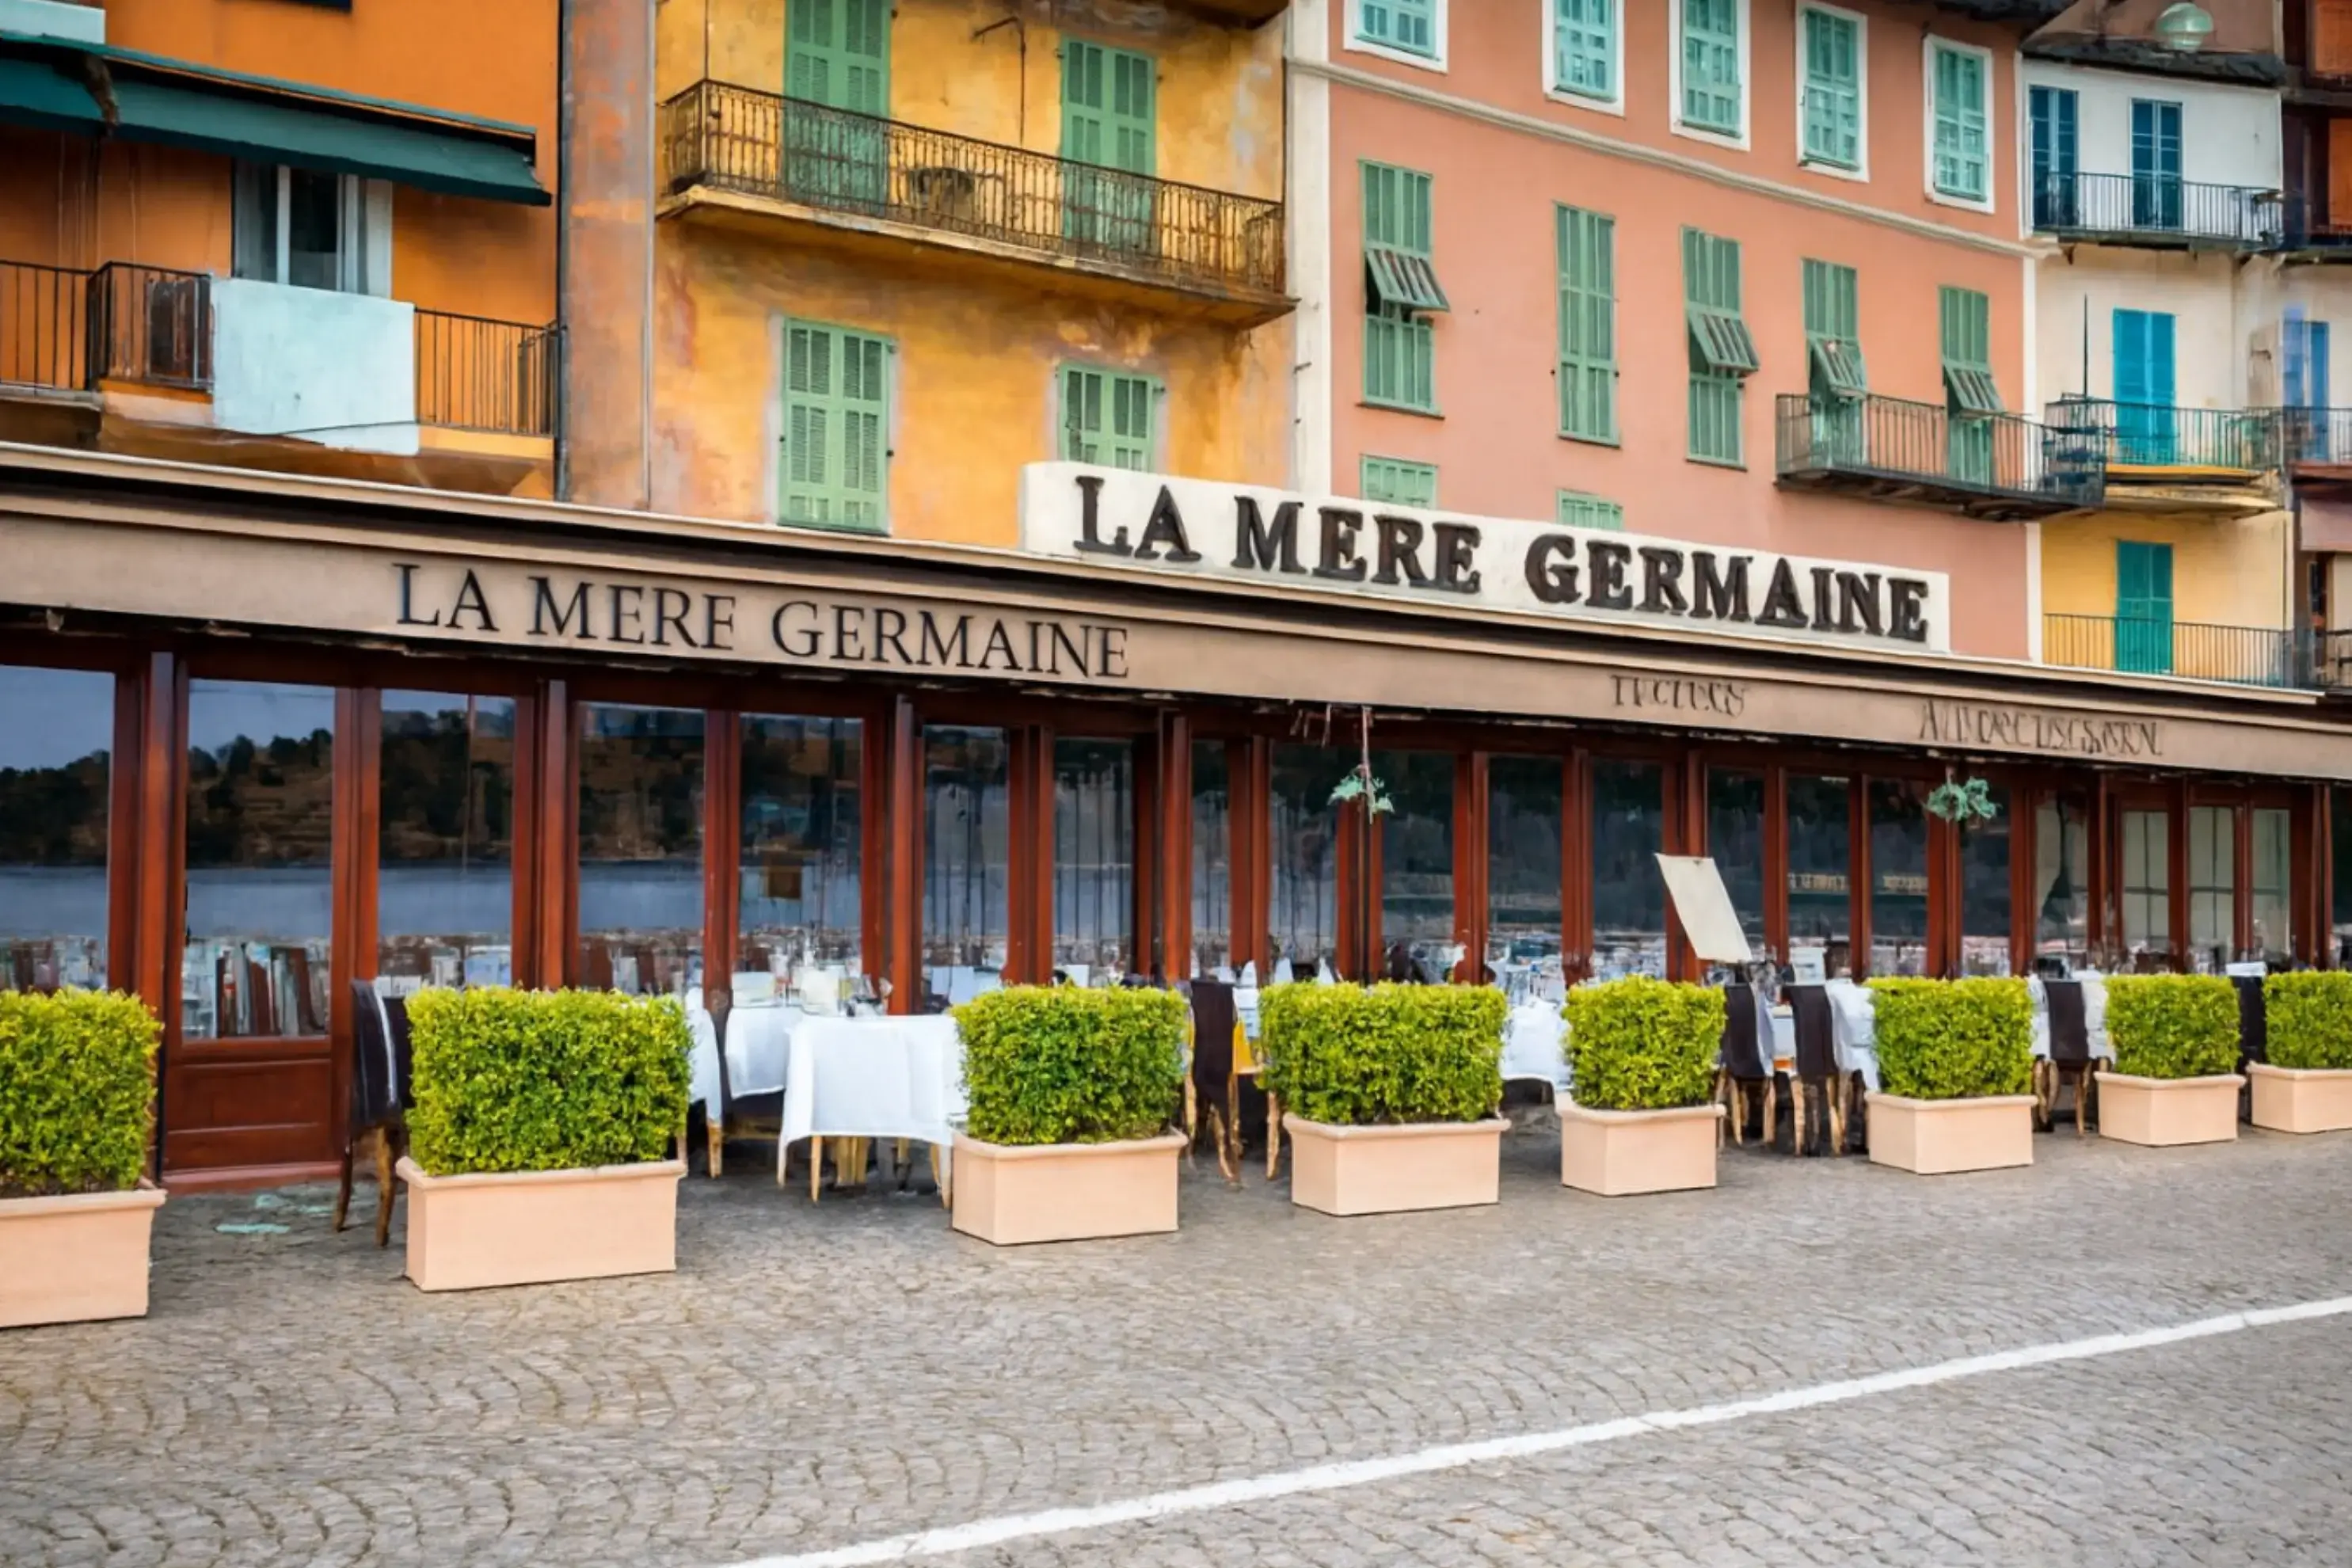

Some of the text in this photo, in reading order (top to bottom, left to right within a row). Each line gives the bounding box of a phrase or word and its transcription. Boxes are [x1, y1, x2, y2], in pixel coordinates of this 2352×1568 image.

[392, 563, 1129, 679] LA MERE GERMAINE
[1074, 476, 1928, 642] LA MERE GERMAINE
